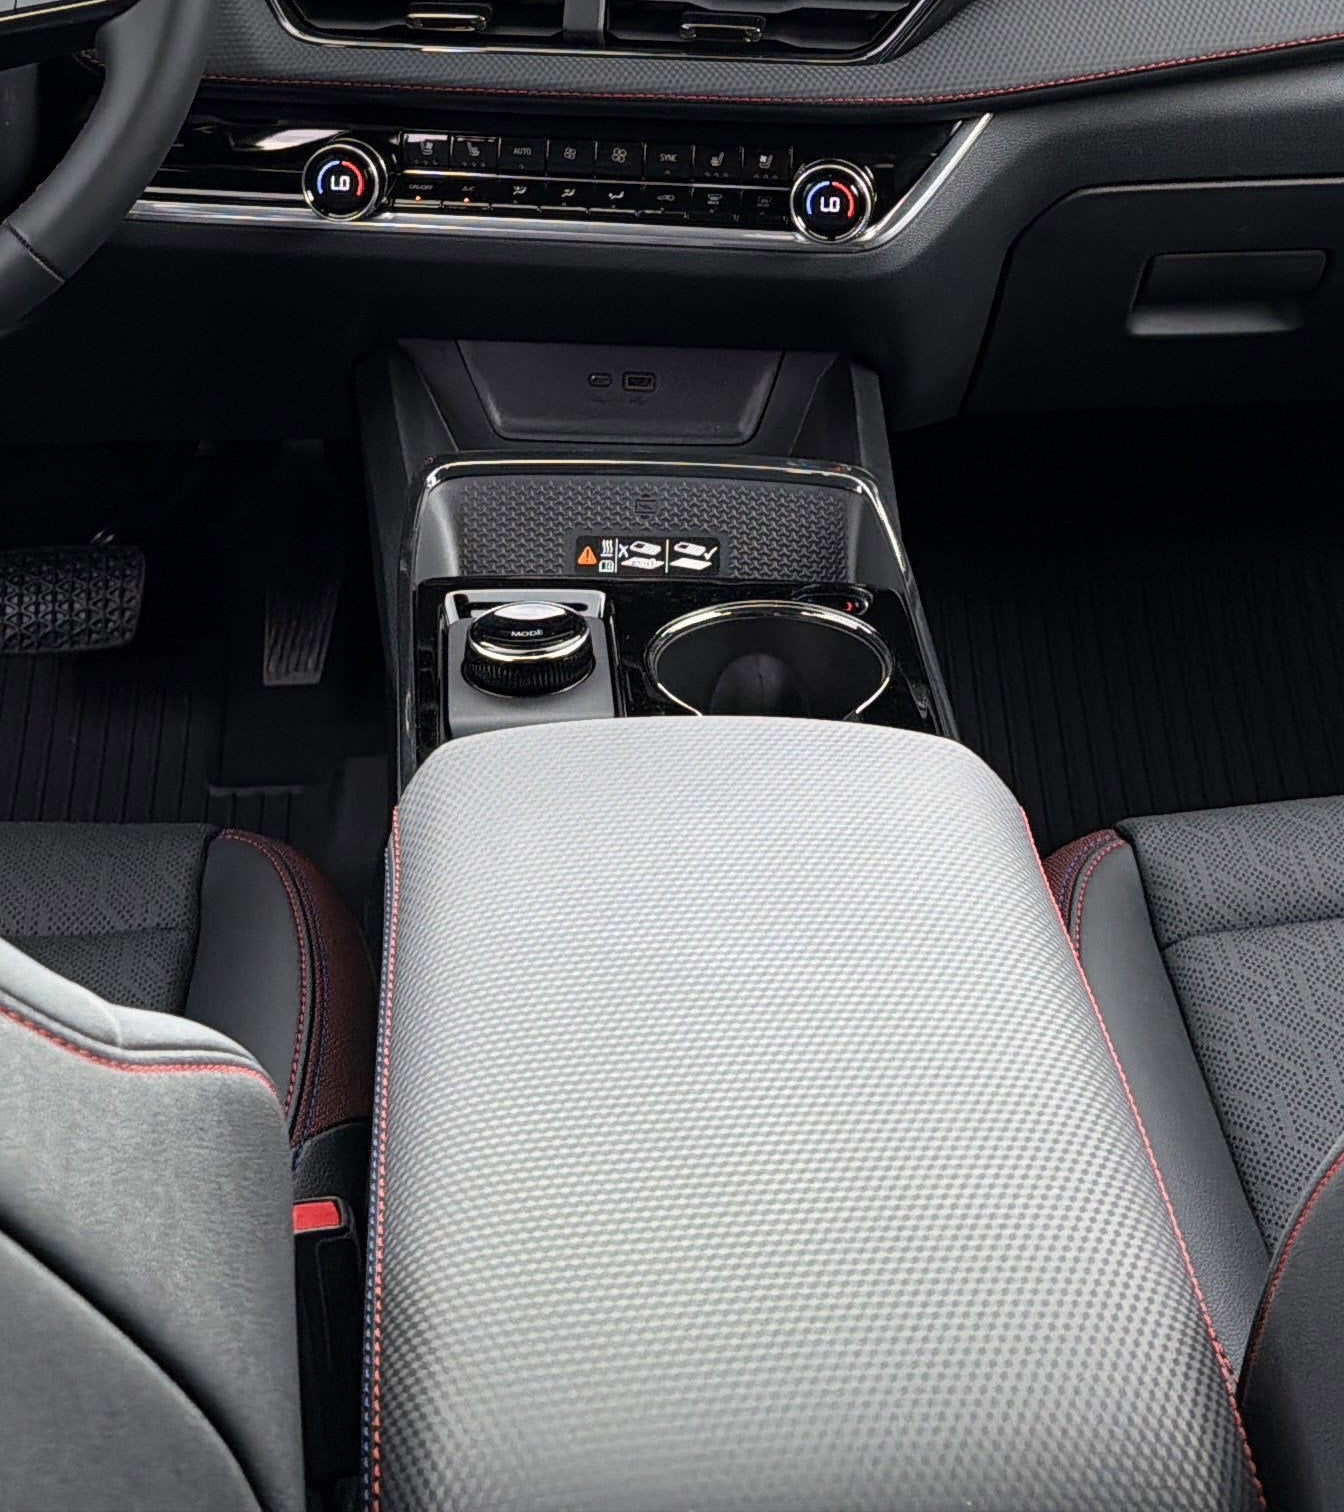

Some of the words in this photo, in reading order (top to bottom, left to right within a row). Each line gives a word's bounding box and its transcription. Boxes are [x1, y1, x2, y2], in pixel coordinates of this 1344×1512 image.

[513, 147, 531, 155] AUTO
[660, 153, 678, 162] SYNC
[511, 628, 544, 638] MODE
